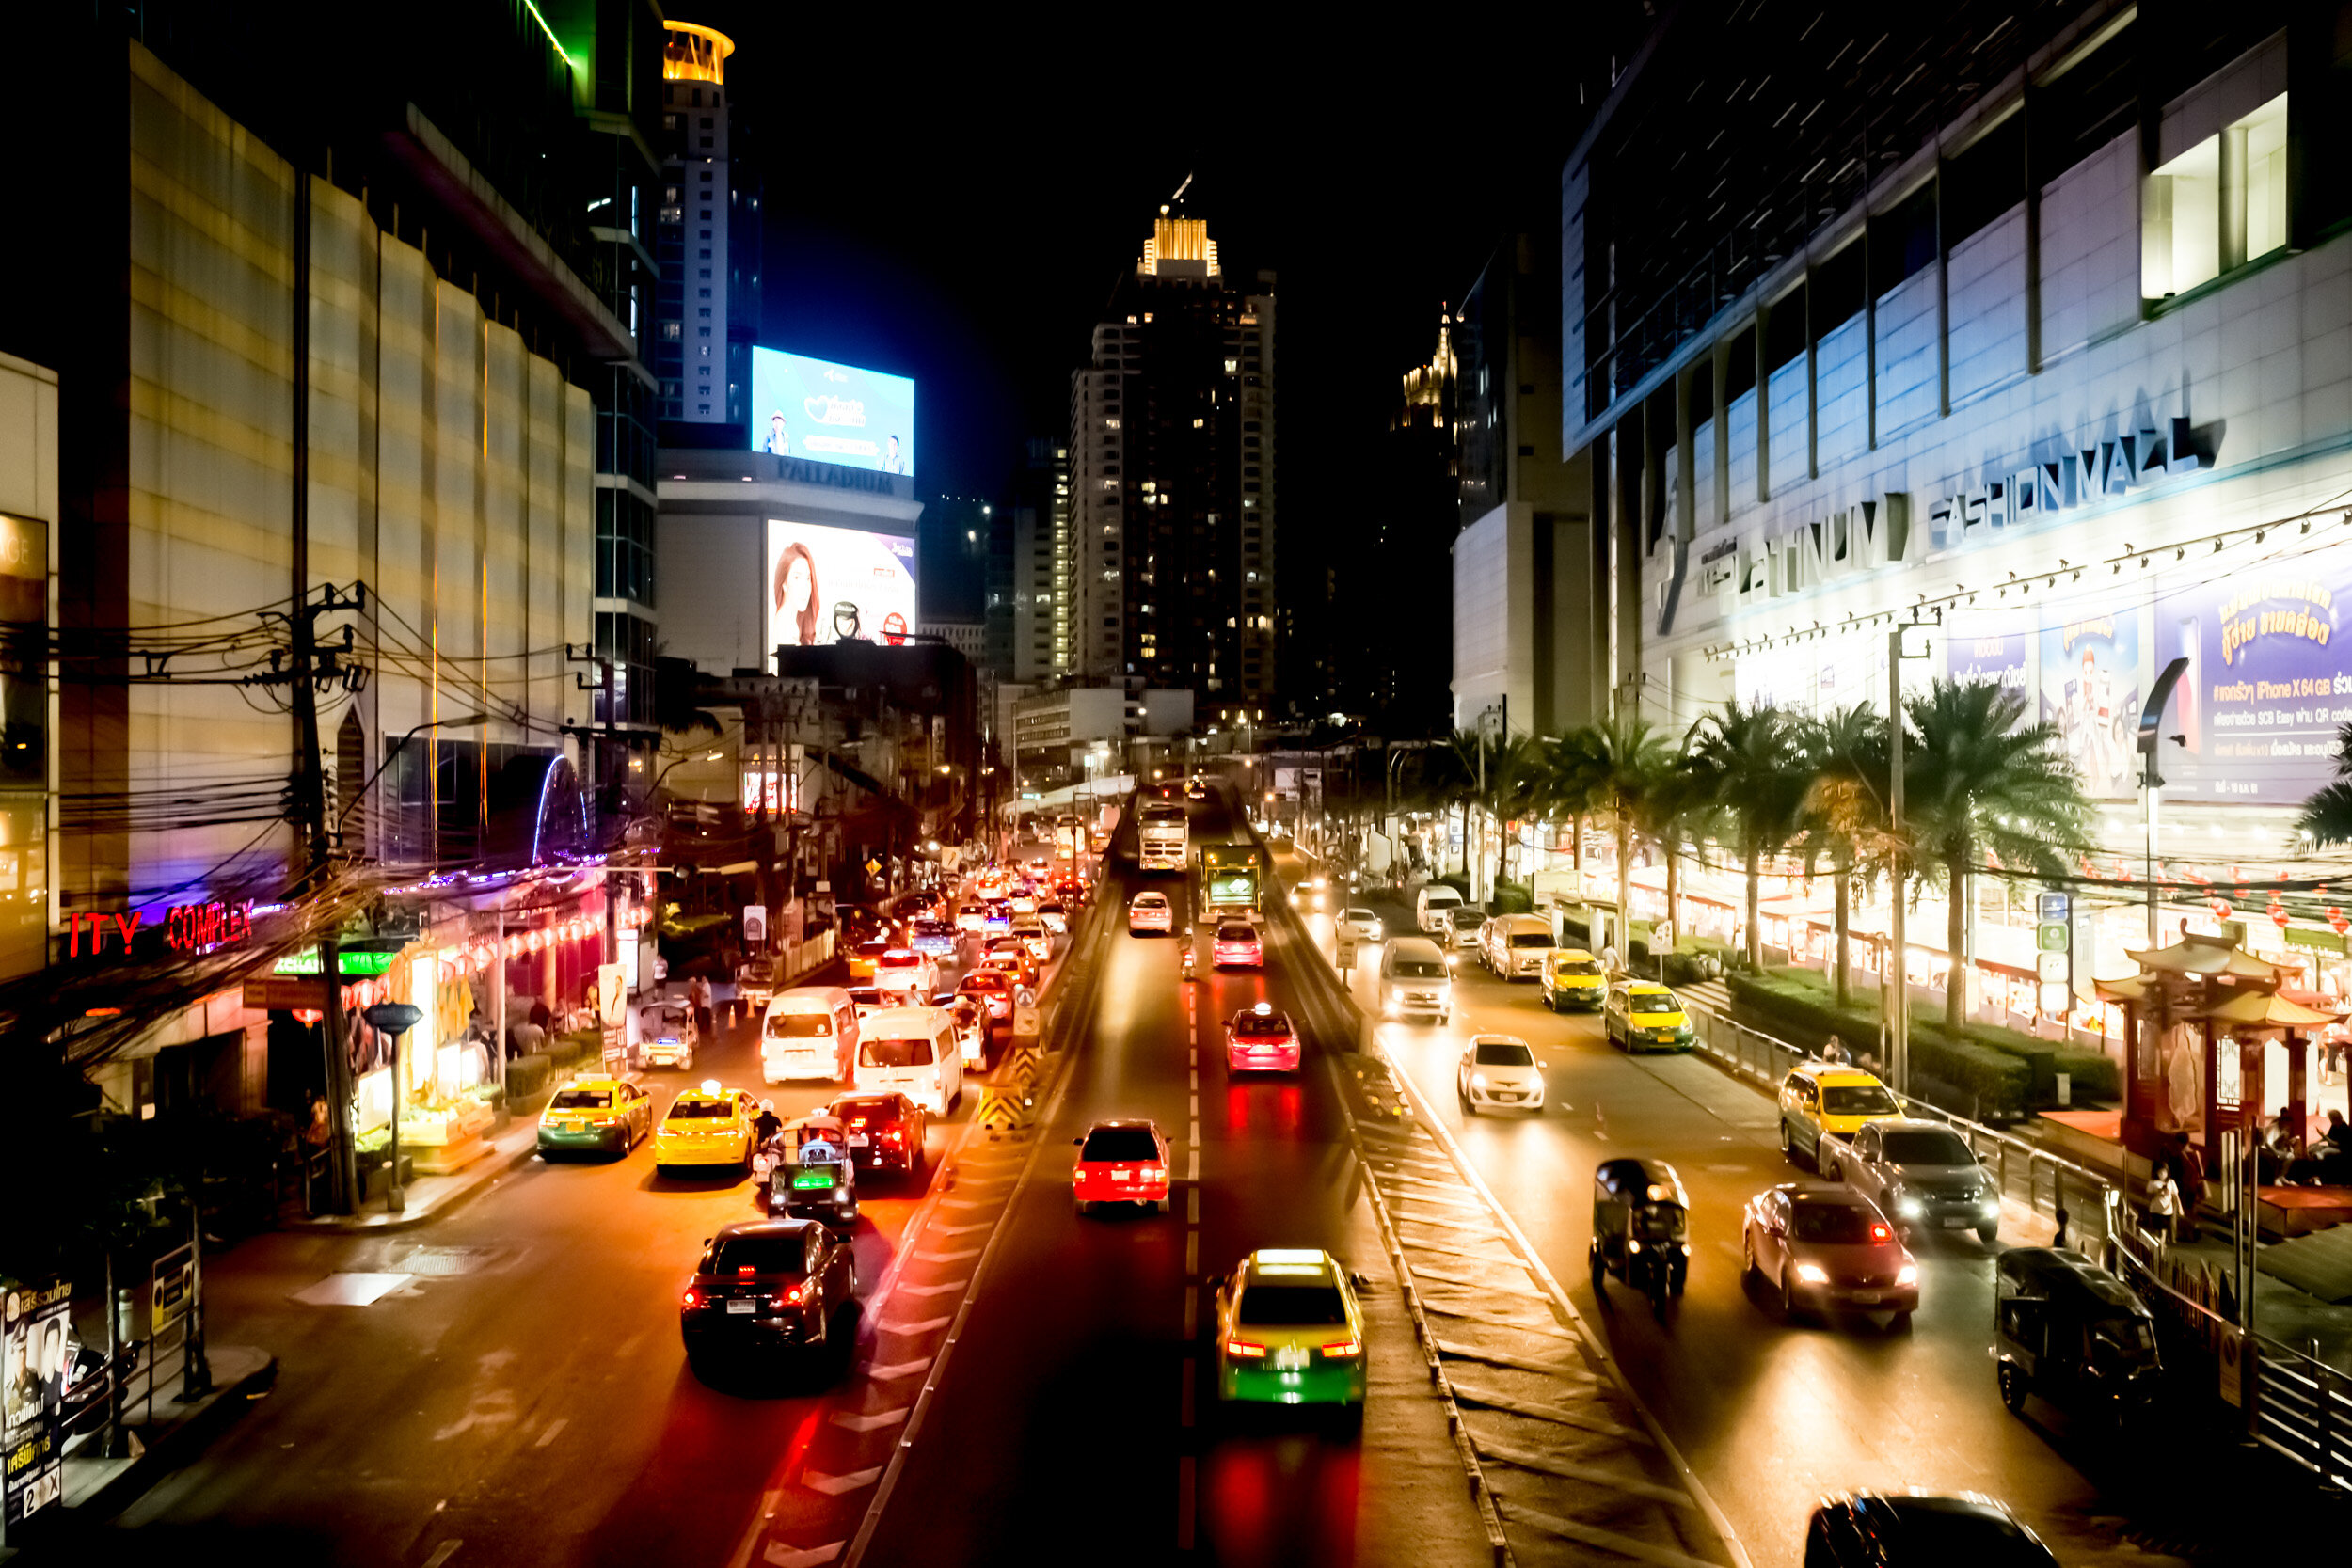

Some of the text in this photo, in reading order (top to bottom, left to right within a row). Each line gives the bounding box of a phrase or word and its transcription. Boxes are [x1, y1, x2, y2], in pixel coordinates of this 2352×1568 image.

[1929, 417, 2203, 549] FASHION MALL
[2257, 680, 2292, 700] iPhone
[2293, 678, 2300, 698] X
[2301, 677, 2314, 697] 64
[2314, 678, 2331, 696] GB
[2257, 710, 2274, 726] SCB
[2276, 709, 2295, 727] Easy
[2315, 707, 2329, 724] QR
[169, 897, 254, 951] COMPLEX
[25, 1487, 35, 1514] 2
